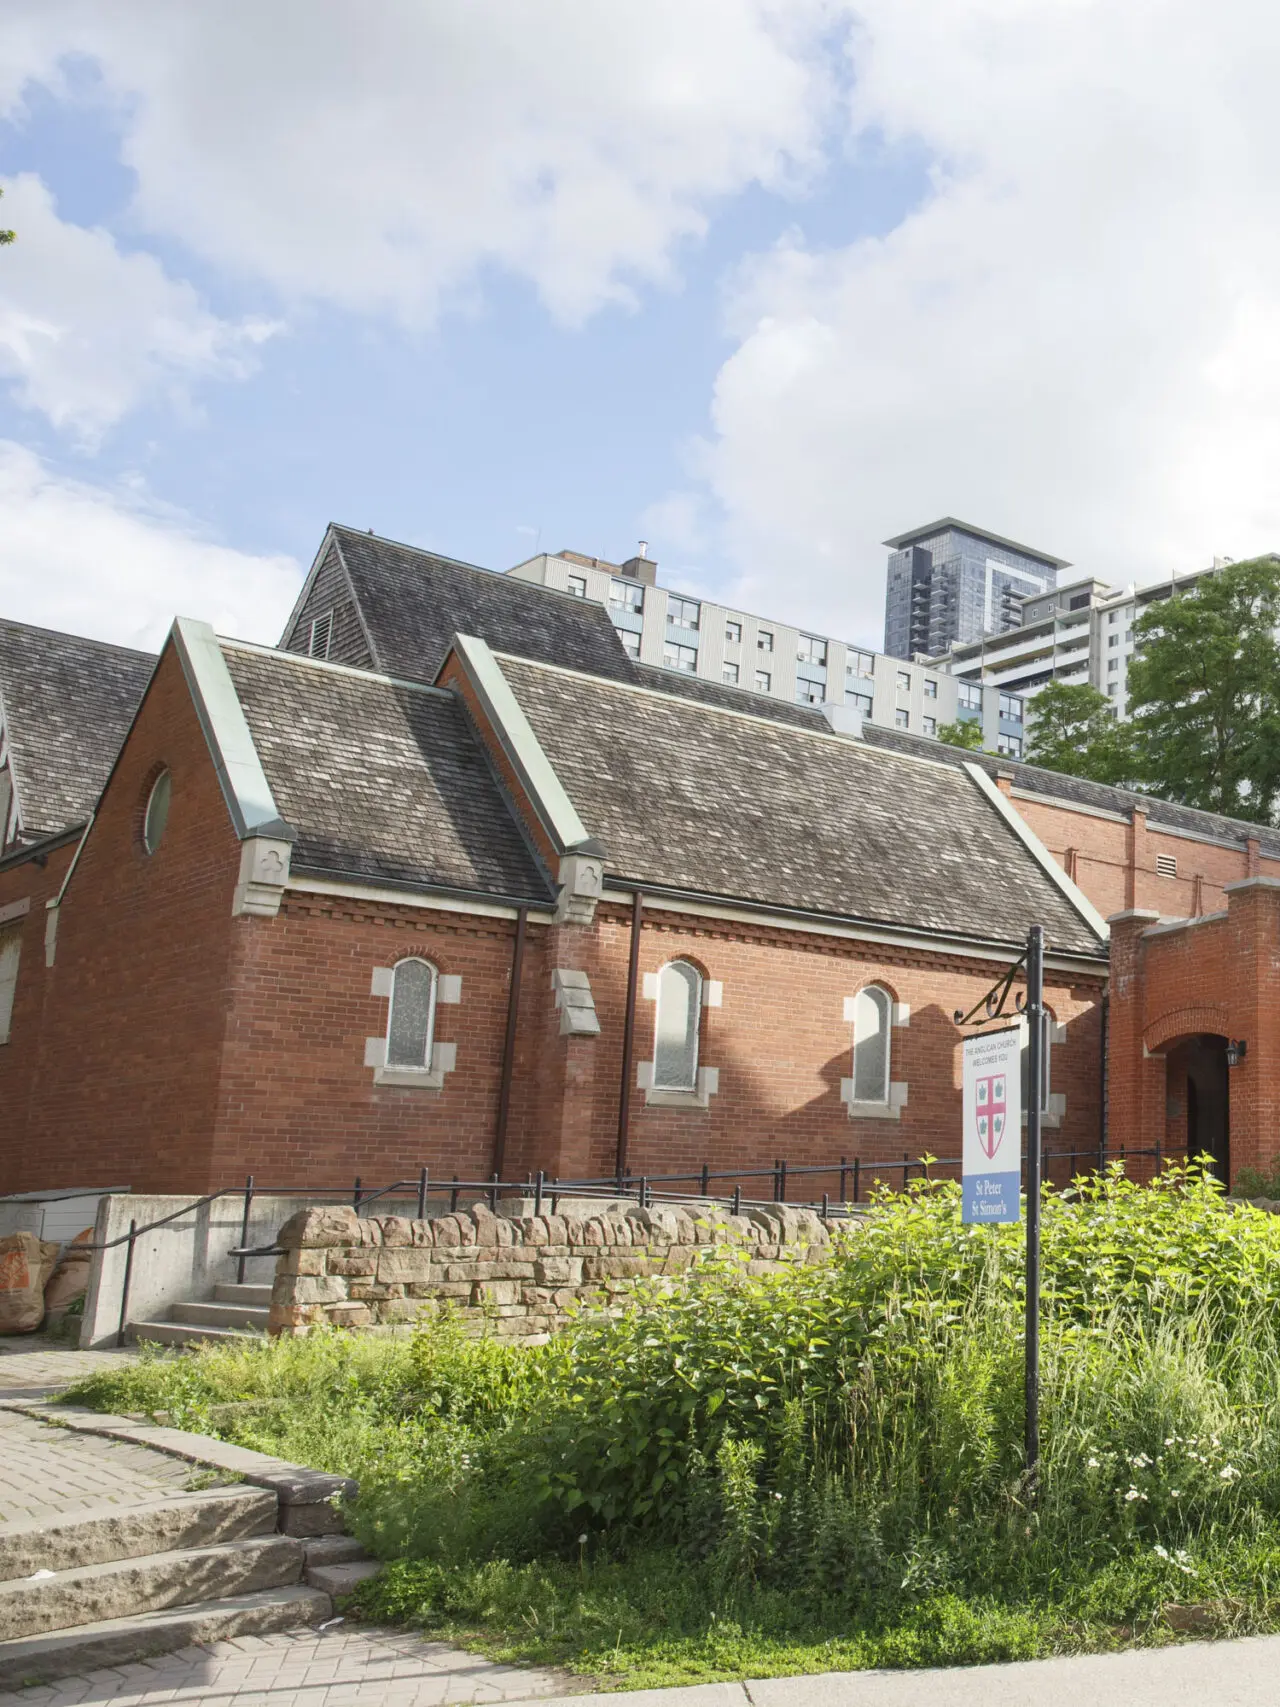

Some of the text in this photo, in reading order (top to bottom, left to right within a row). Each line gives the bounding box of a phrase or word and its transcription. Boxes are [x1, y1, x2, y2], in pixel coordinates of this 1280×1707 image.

[965, 1038, 1017, 1057] THE ANGLICAN CHURCH
[972, 1053, 1008, 1067] WELCOMES YOU
[975, 1179, 1003, 1196] St Peter
[971, 1199, 1008, 1217] St Simon's
